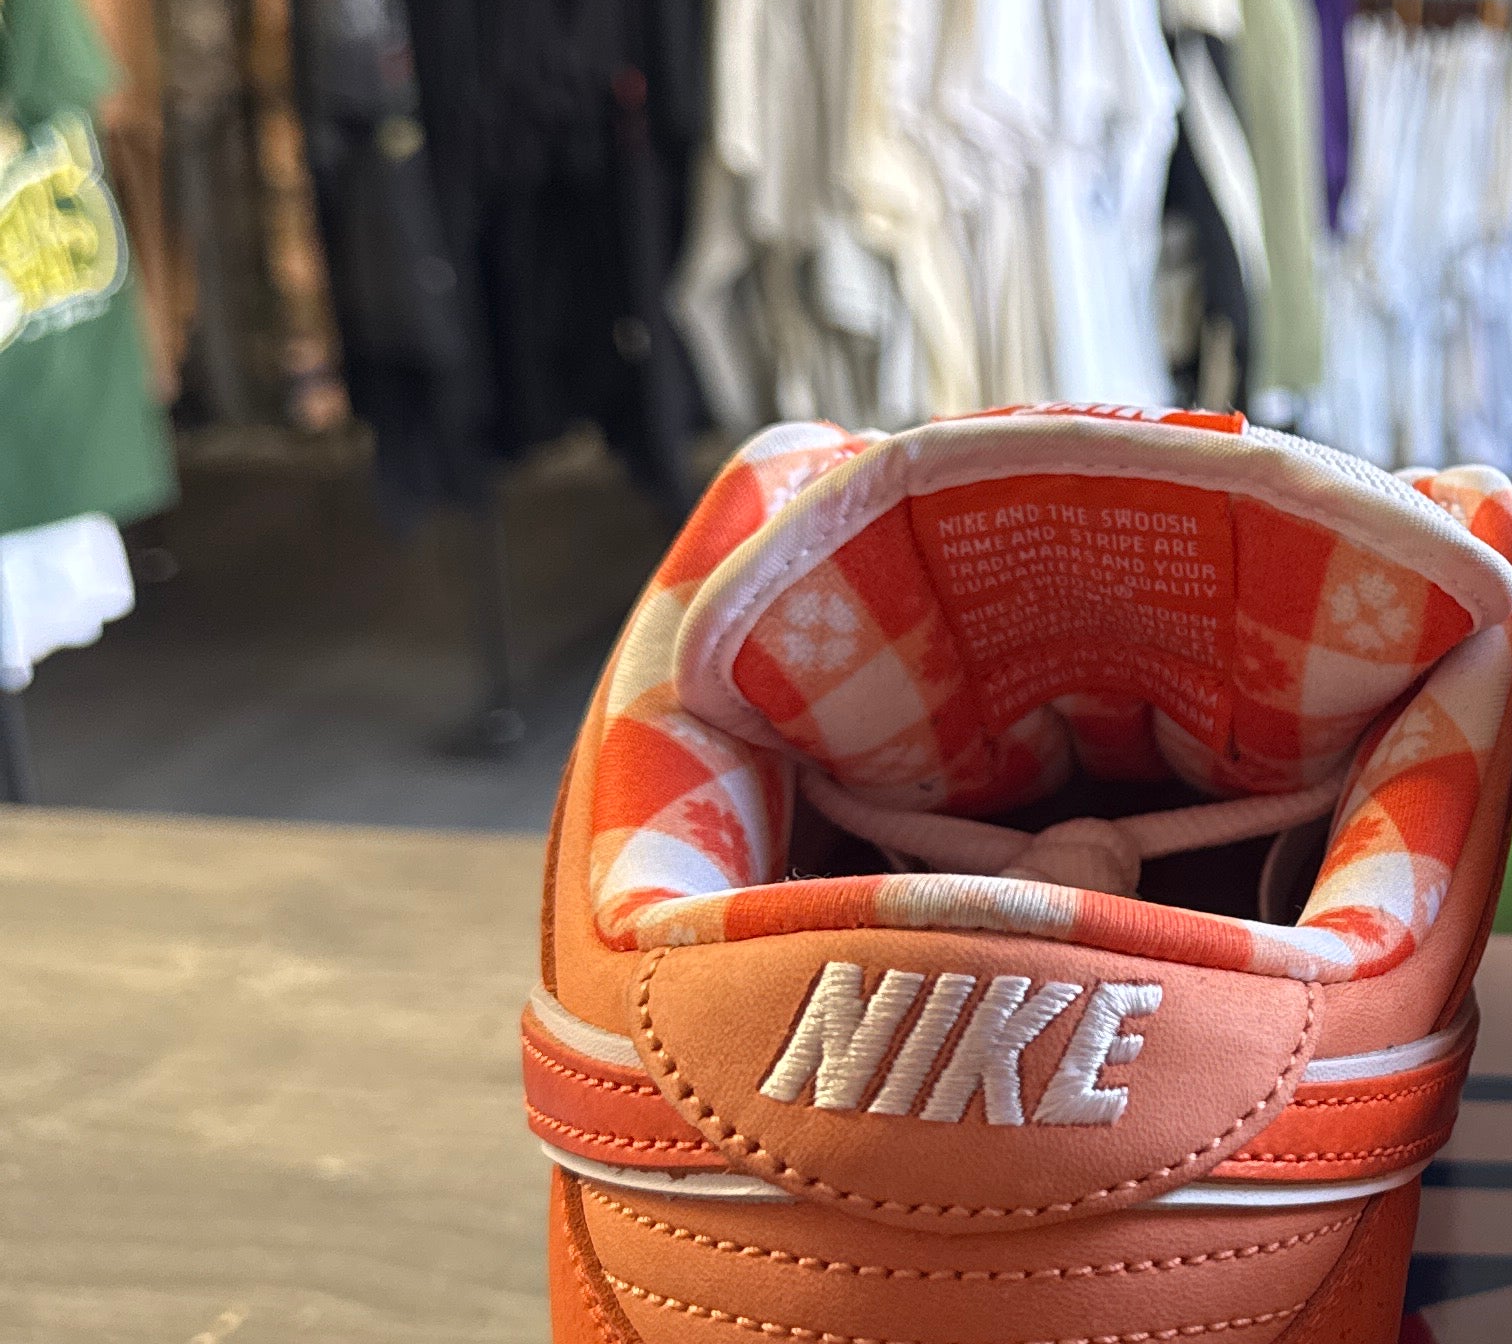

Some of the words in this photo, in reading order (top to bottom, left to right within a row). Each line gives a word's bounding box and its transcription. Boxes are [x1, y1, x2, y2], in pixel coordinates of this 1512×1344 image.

[939, 511, 988, 538] NIKE
[995, 503, 1040, 529] AND
[1046, 504, 1088, 526] THE
[1101, 508, 1198, 535] SWOOSH
[942, 532, 1005, 560] NAME
[1011, 525, 1056, 547] AND
[1070, 528, 1144, 554] STRIPE
[1154, 538, 1198, 557] ARE
[949, 544, 1095, 579] TRADEMARKS
[1102, 553, 1145, 574] AND
[1154, 560, 1217, 580] YOUR
[1123, 573, 1217, 598] QUALITY
[759, 961, 1163, 1126] NIKE
